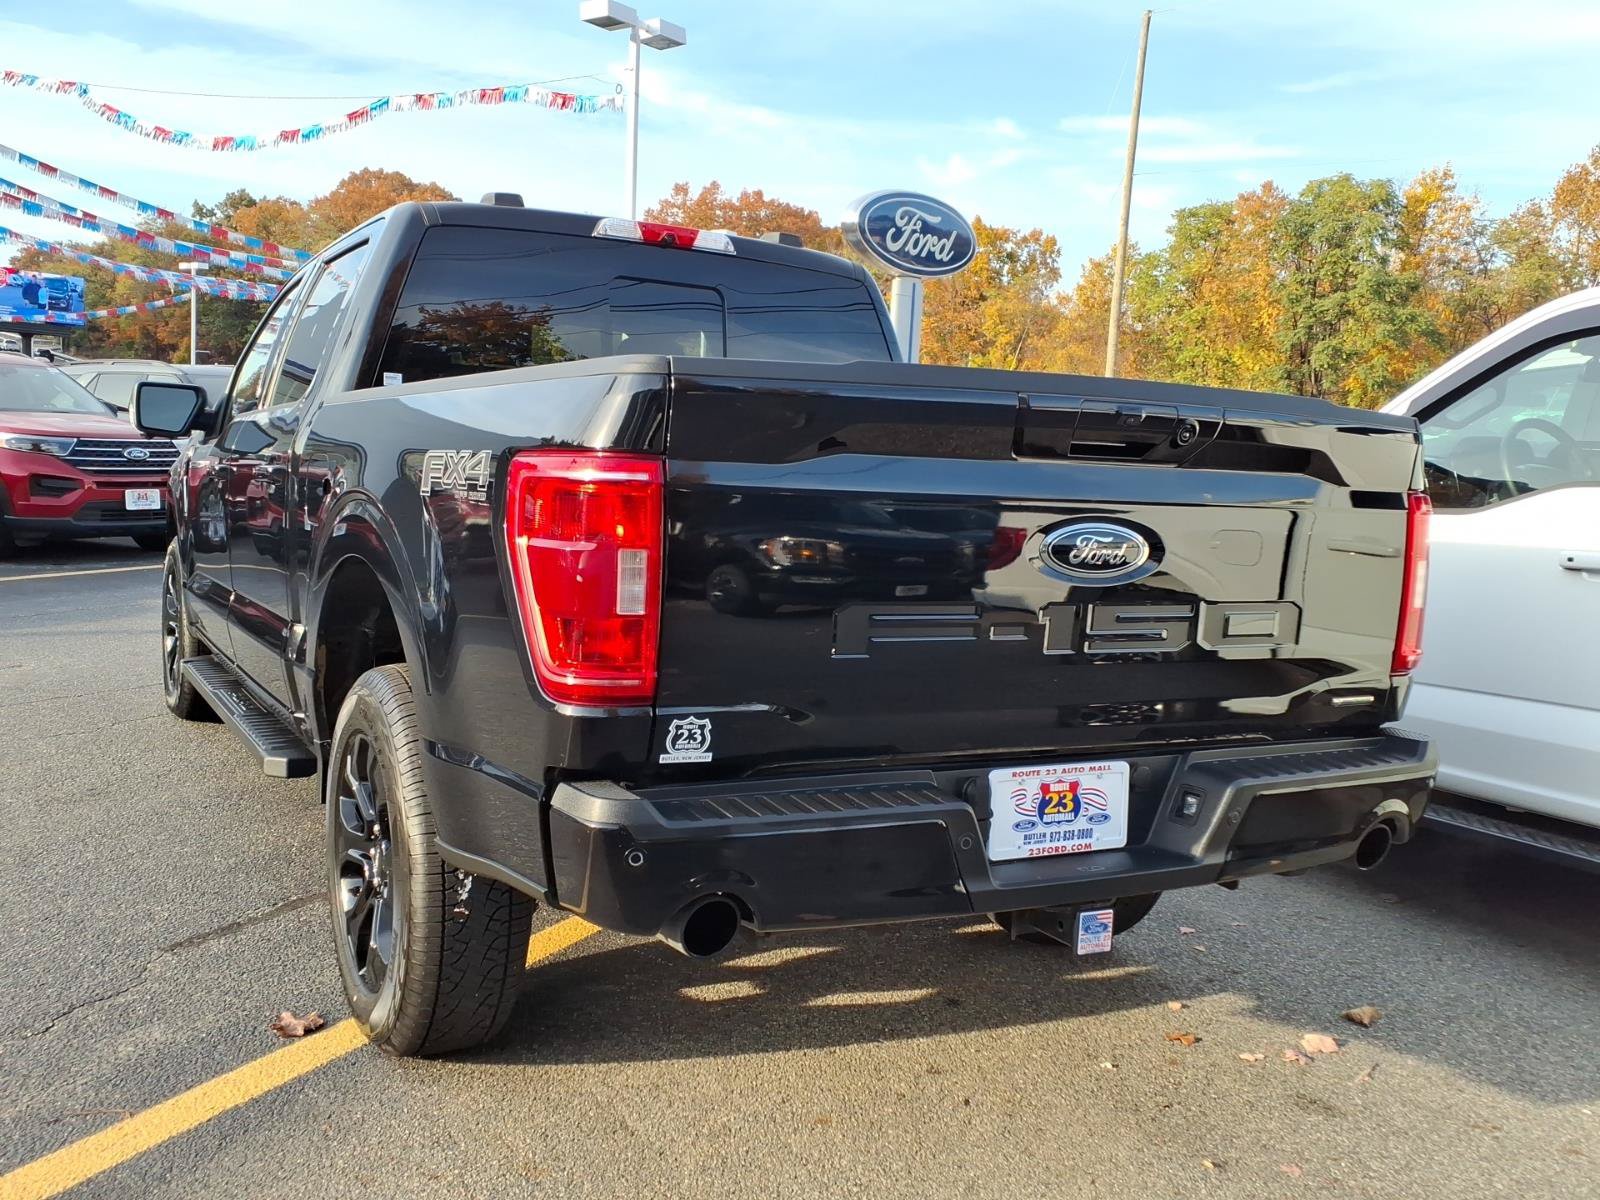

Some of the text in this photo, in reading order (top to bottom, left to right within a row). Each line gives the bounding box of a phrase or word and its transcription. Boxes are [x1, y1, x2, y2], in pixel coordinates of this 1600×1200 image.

[886, 206, 957, 262] Ford
[420, 450, 492, 496] FX4
[1069, 534, 1126, 566] Ford
[830, 601, 1301, 658] F-150
[676, 729, 702, 743] 23
[1012, 764, 1113, 778] ROUTE 23 AUTO MALL
[1049, 782, 1070, 791] ROUTE
[1044, 791, 1075, 814] 23
[1042, 812, 1075, 823] AUTOMALL
[1023, 832, 1047, 841] BUTLER
[1028, 843, 1092, 856] 23FORD.COM
